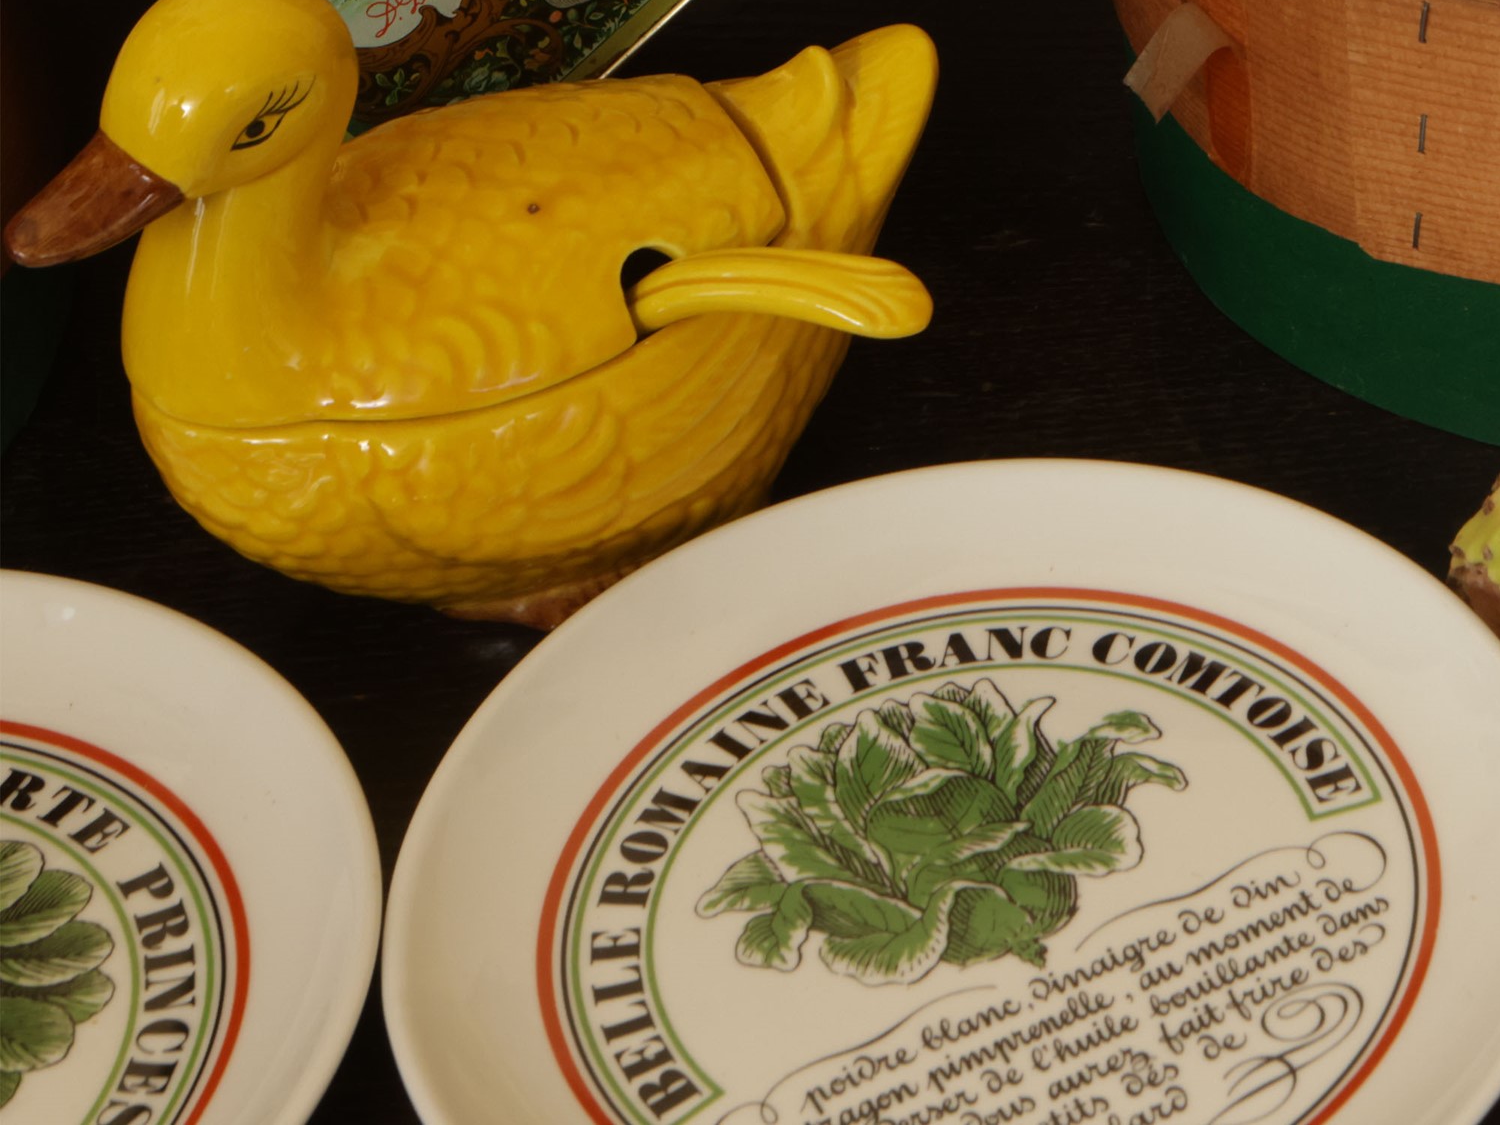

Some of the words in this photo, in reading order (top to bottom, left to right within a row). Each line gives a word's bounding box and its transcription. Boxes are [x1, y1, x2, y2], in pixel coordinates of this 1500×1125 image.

[837, 626, 1072, 695] FRANC
[1092, 631, 1363, 808] COMTOISE
[597, 679, 831, 909] ROMAINE
[981, 1068, 1024, 1094] de
[1031, 1015, 1139, 1072] l'huile
[1149, 933, 1315, 1017] bouillante
[1316, 897, 1389, 937] dans
[1140, 961, 1184, 991] au
[1185, 890, 1322, 967] moment
[1315, 878, 1362, 903] de
[1178, 908, 1224, 935] de
[590, 927, 702, 1120] BELLE
[1048, 1047, 1151, 1101] aurez
[1159, 1003, 1225, 1055] fait
[1226, 968, 1309, 1022] frire
[1311, 928, 1382, 972] des
[1197, 1033, 1247, 1061] de
